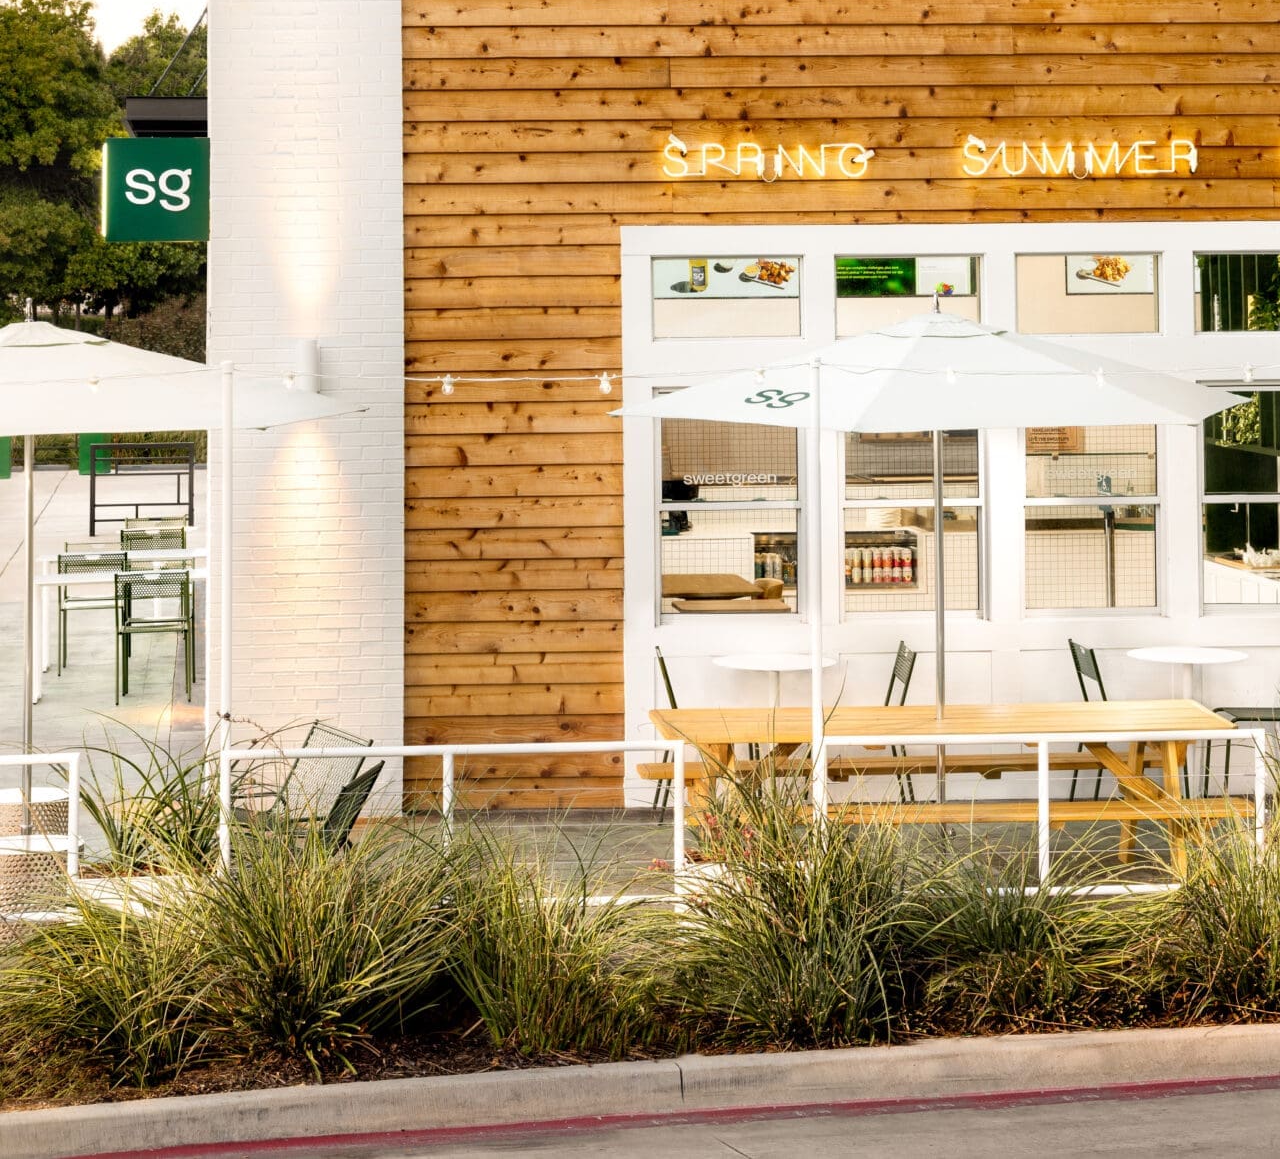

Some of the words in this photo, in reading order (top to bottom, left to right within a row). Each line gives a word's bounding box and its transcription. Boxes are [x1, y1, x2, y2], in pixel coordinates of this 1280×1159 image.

[661, 141, 871, 179] SPRING
[962, 138, 1198, 179] SUMMER
[124, 167, 193, 213] sg
[744, 389, 811, 409] sg
[682, 472, 777, 487] sweetgreen
